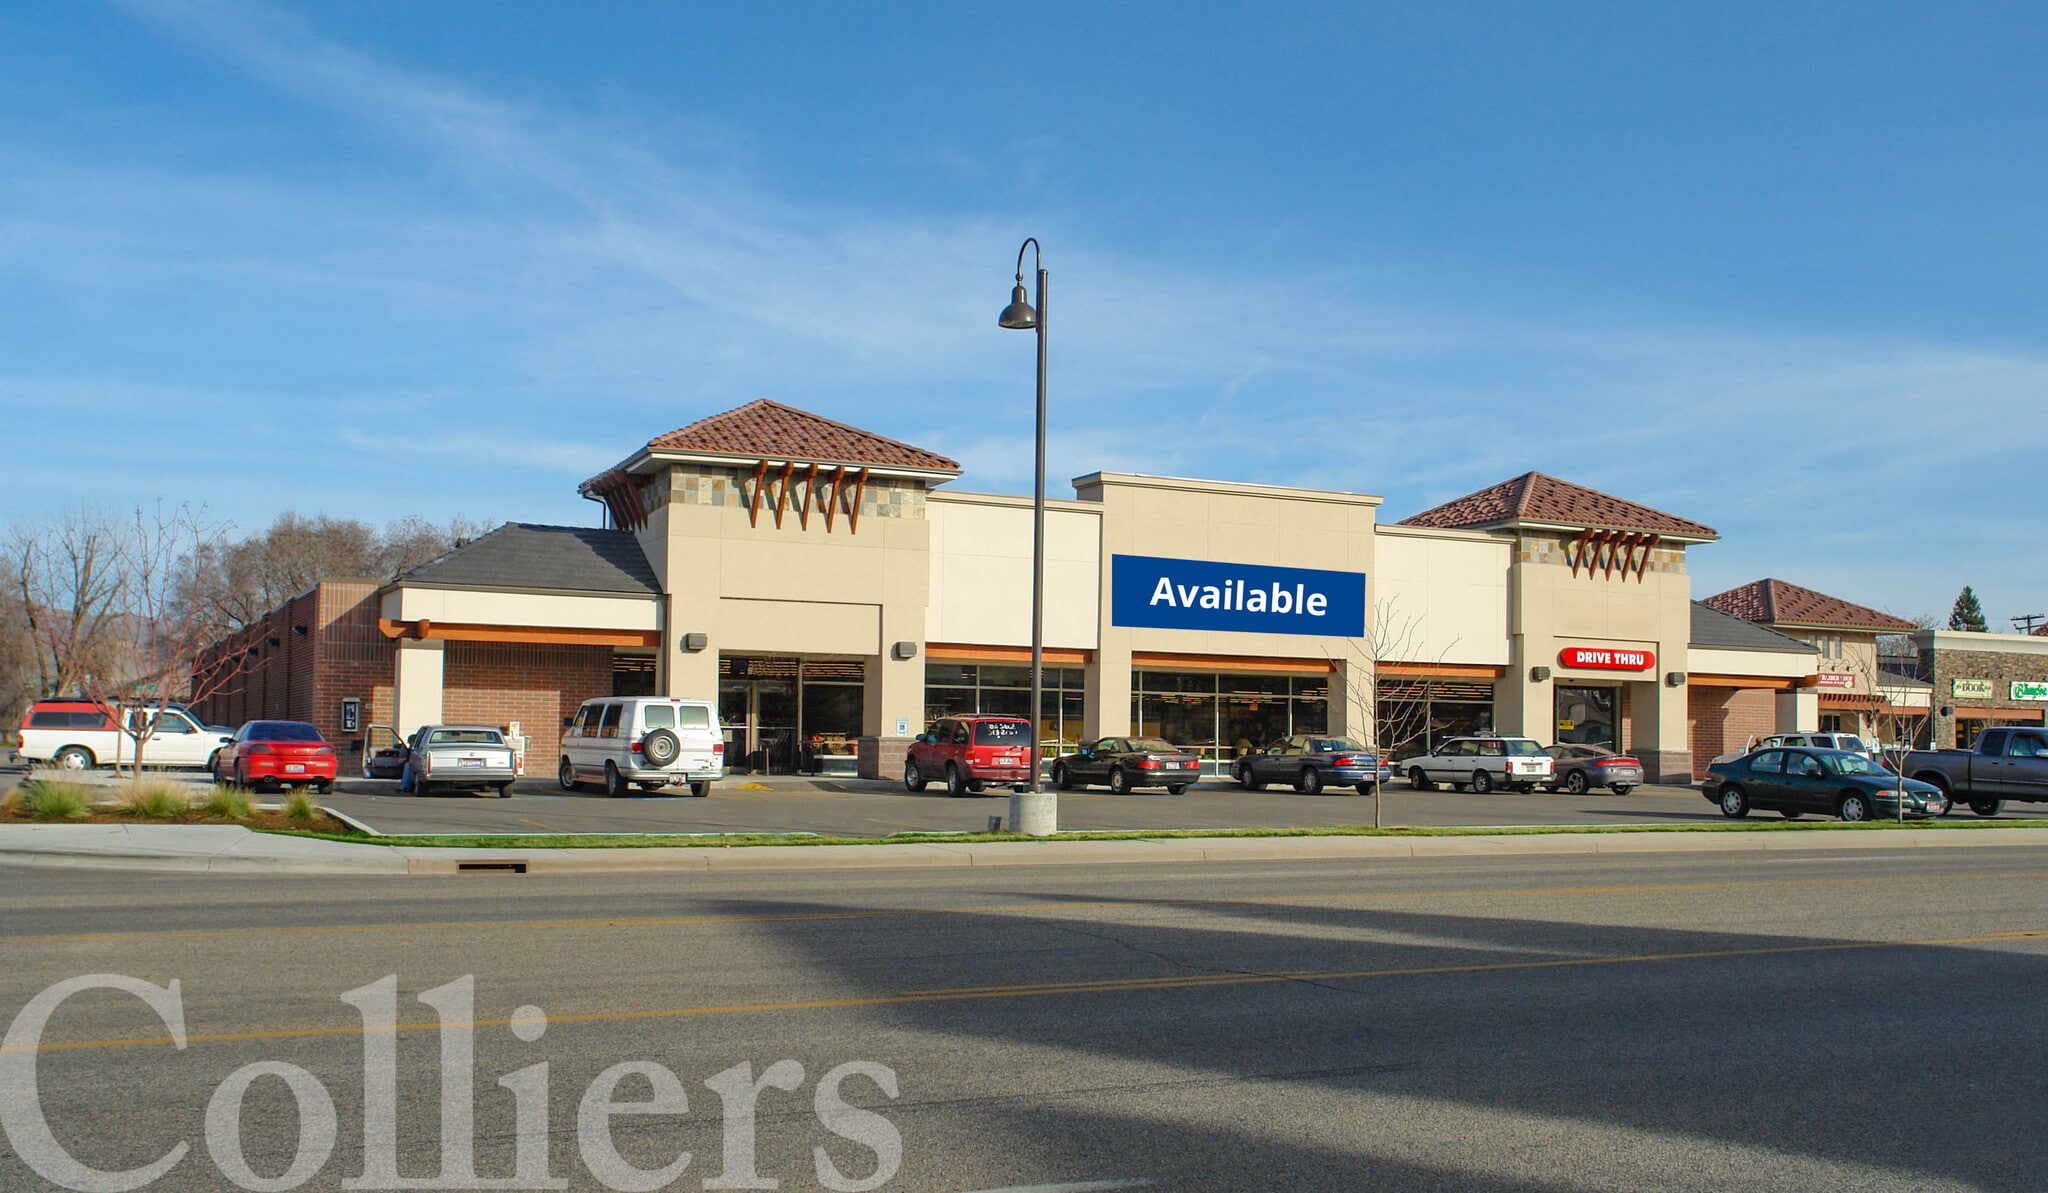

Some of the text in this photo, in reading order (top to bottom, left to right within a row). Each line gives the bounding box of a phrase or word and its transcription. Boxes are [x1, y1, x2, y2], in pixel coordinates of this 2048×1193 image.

[1150, 576, 1328, 617] Available
[1576, 651, 1645, 666] DRIVE THRU
